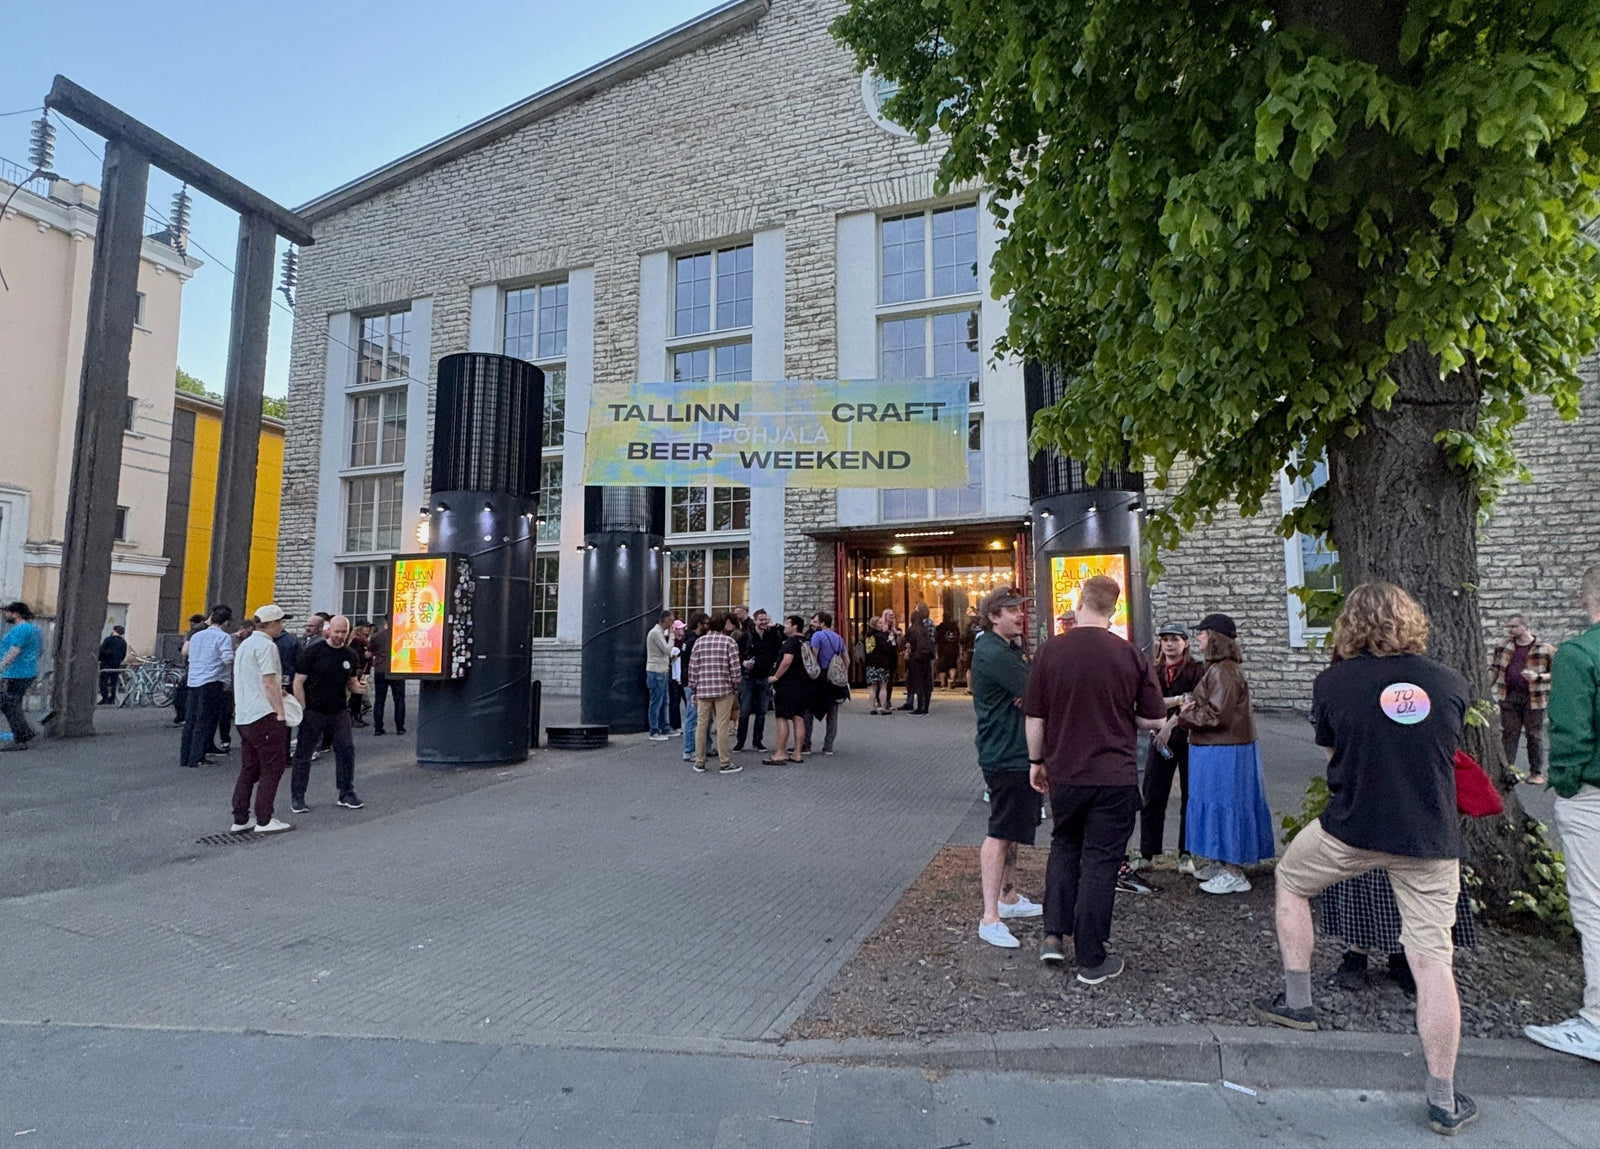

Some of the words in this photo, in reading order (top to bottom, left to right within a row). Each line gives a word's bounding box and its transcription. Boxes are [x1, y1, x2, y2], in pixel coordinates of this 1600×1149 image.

[607, 402, 741, 422] TALLINN
[831, 401, 946, 423] CRAFT
[718, 423, 830, 444] PÕHJALA
[627, 442, 713, 460] BEER
[740, 450, 911, 470] WEEKEND
[396, 570, 434, 581] TALLINN
[396, 581, 427, 592] CRAFT
[410, 612, 432, 623] 226
[402, 639, 433, 649] EDITION
[1393, 688, 1415, 703] TO
